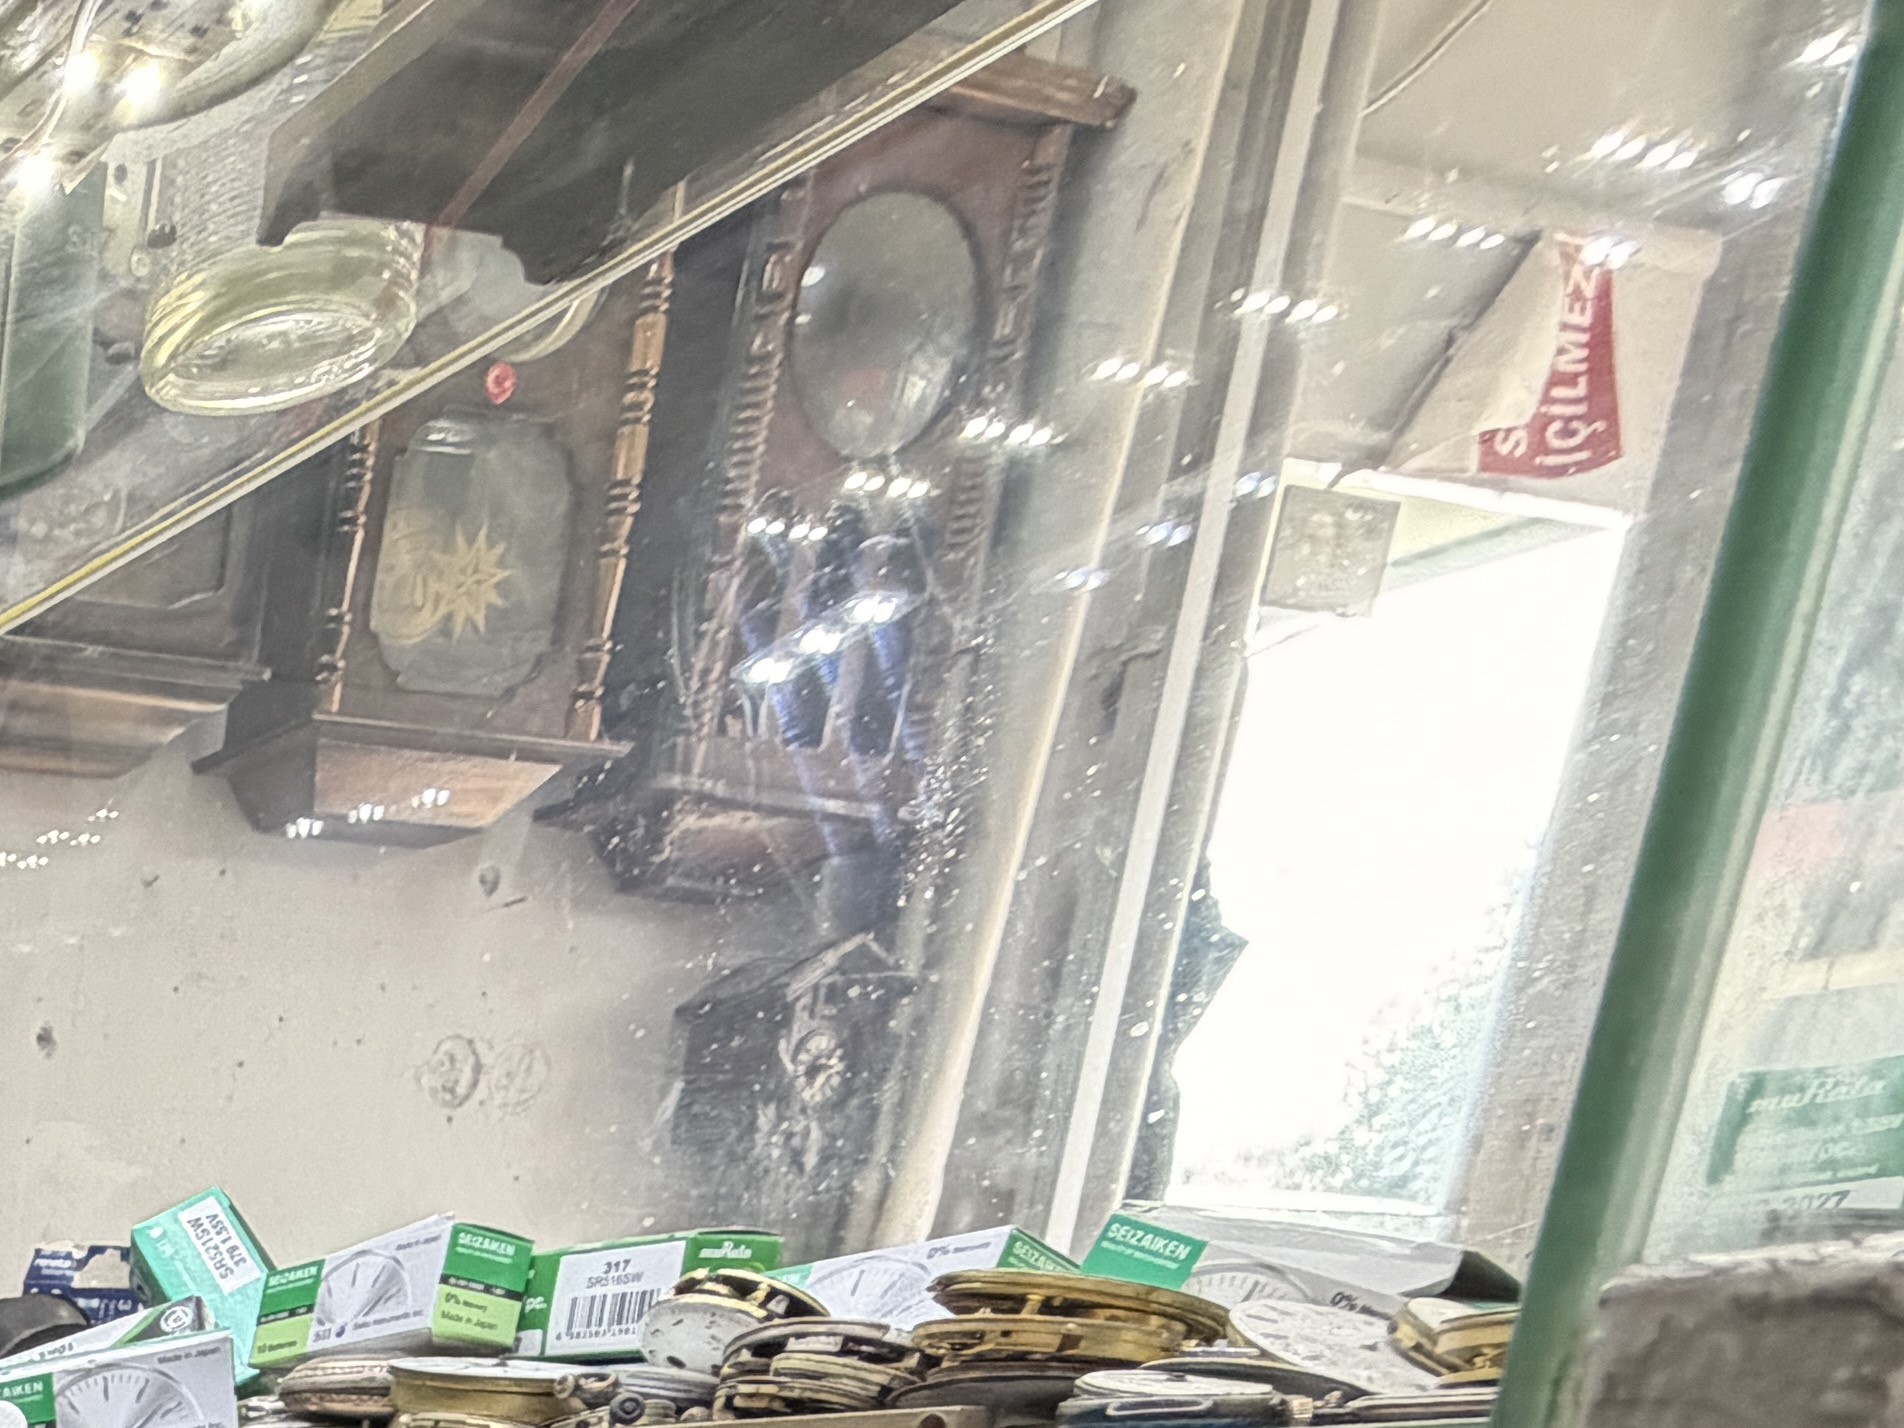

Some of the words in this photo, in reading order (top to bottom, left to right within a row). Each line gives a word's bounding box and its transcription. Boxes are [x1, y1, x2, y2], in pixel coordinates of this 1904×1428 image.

[186, 1216, 235, 1280] SR521SW
[1109, 1221, 1192, 1262] SEIZAIKEN
[602, 1259, 631, 1275] 317
